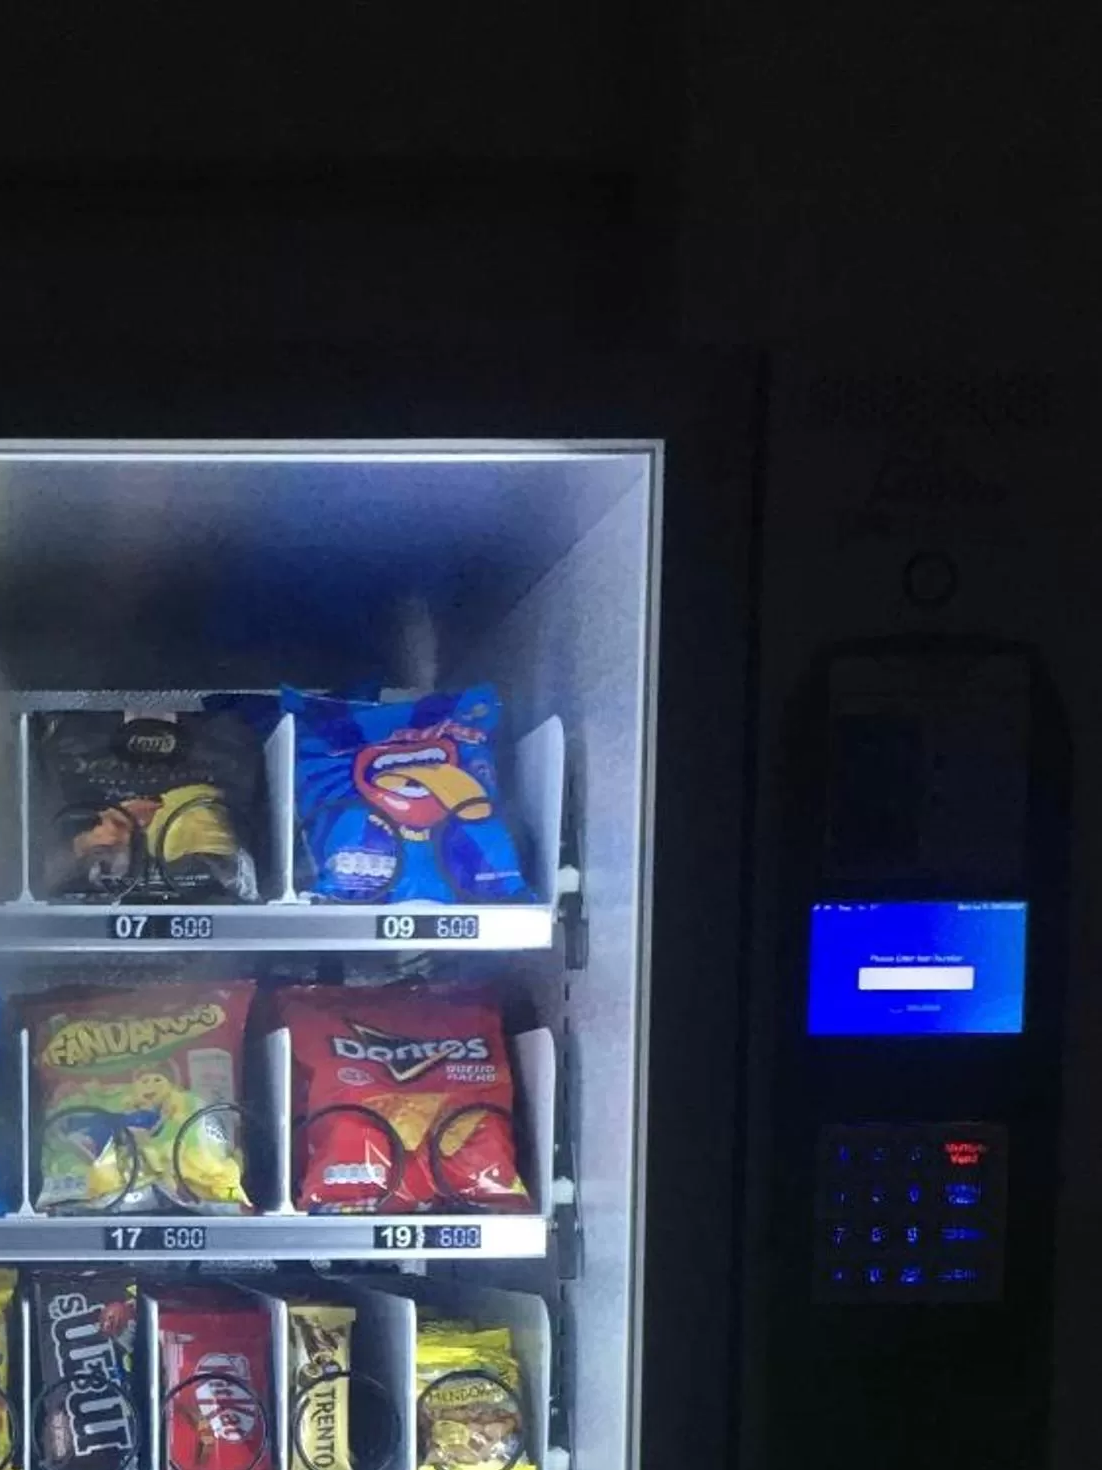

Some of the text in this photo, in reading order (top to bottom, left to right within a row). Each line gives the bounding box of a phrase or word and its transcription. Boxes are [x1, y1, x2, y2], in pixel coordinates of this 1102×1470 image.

[116, 916, 147, 937] 07
[383, 916, 415, 938] 09
[111, 1228, 142, 1249] 17
[381, 1226, 411, 1248] 19
[311, 1386, 337, 1469] TRENTO
